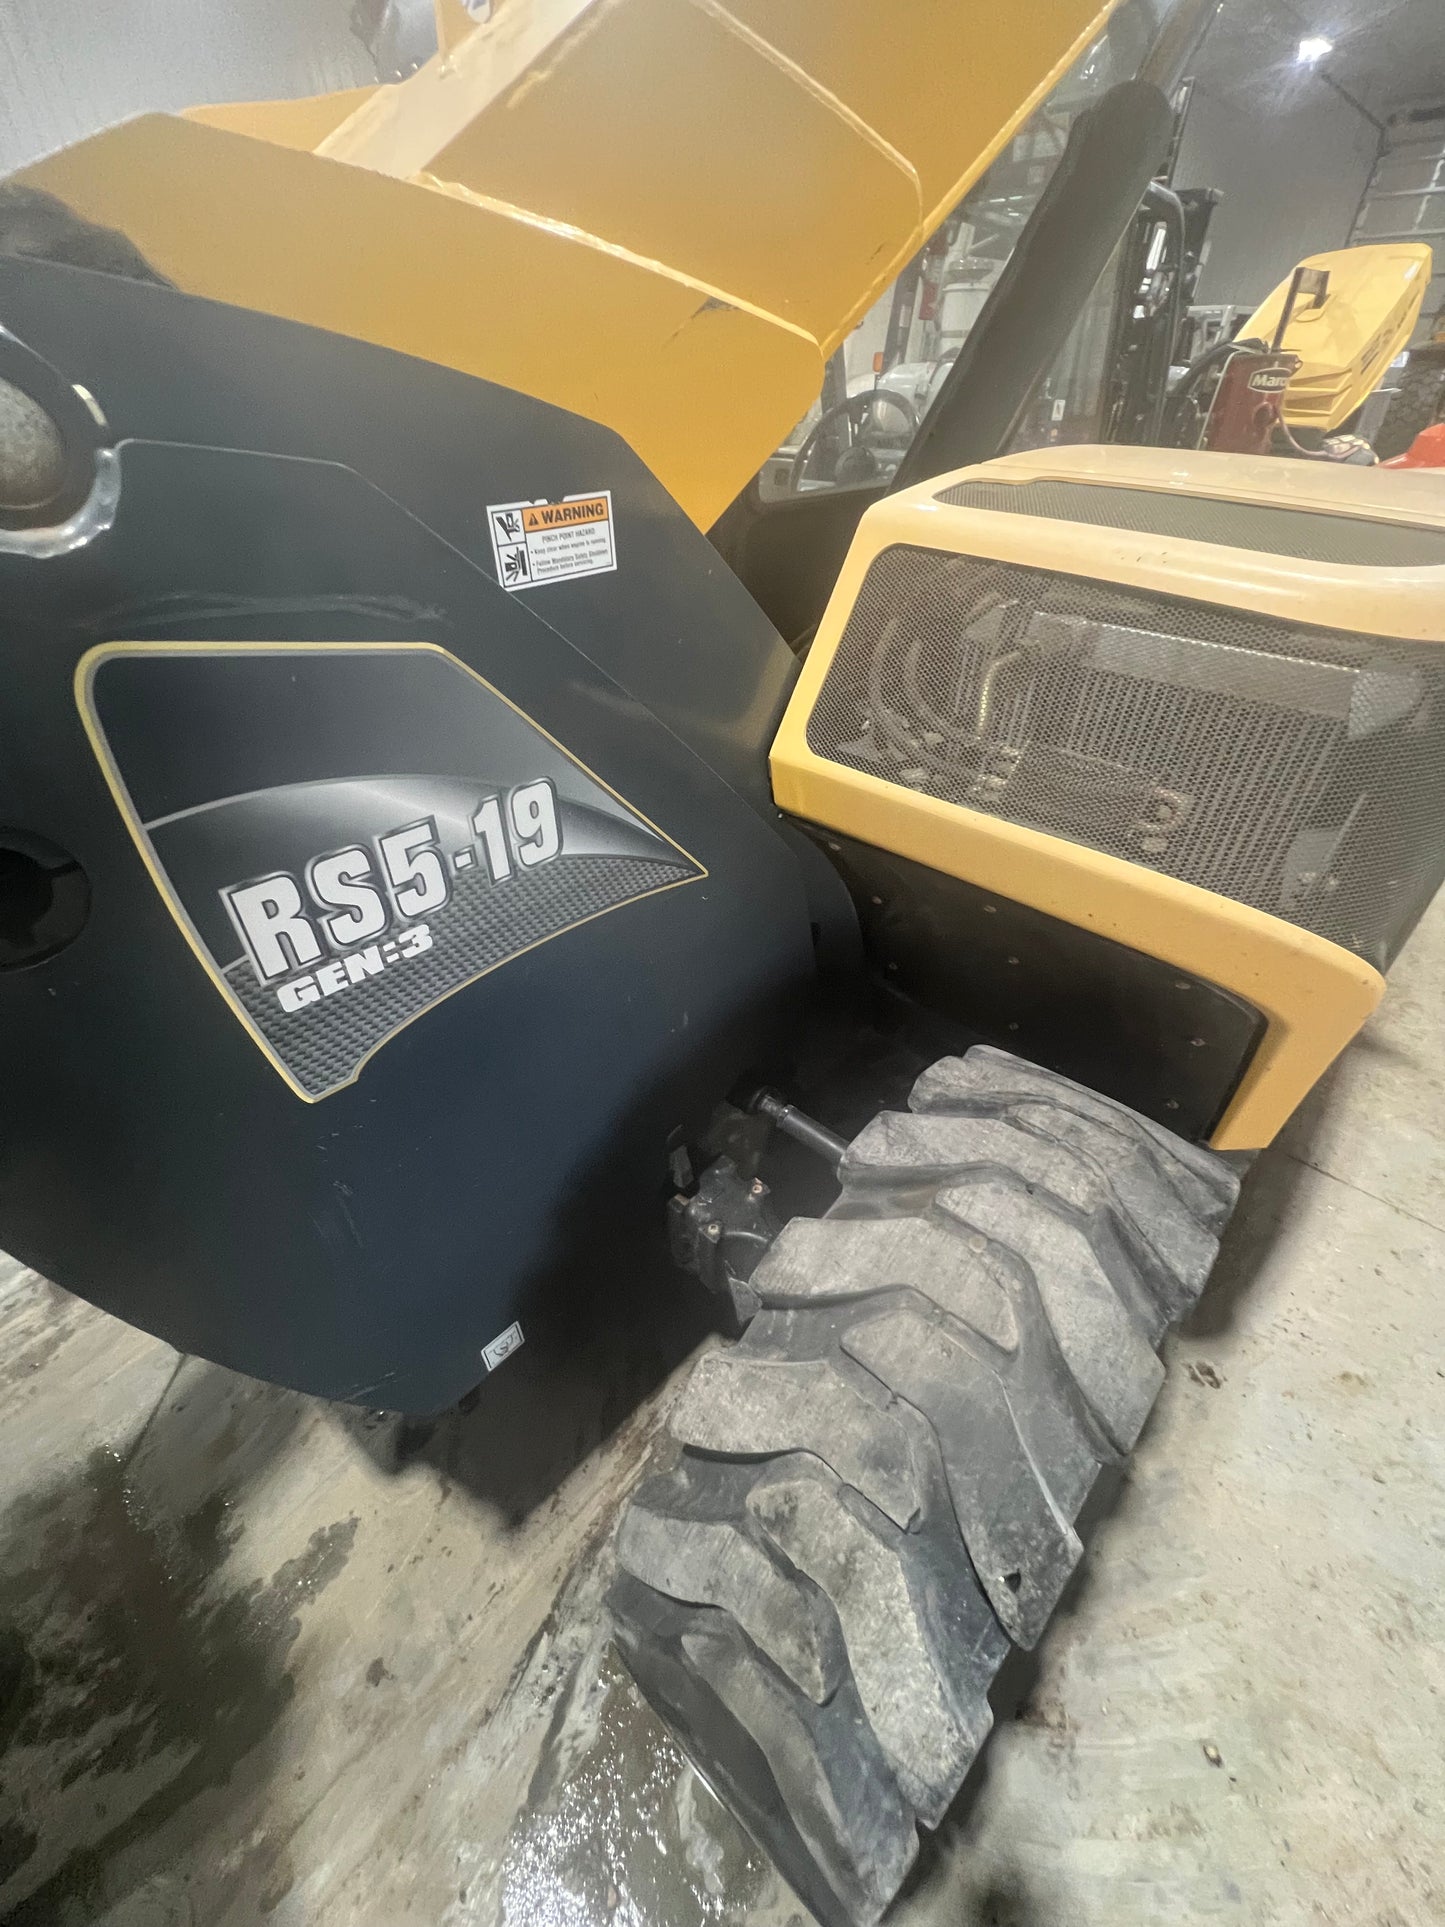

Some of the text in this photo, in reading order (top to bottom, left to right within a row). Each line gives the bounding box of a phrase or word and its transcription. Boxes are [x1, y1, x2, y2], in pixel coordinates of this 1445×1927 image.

[541, 503, 603, 524] WARNING
[542, 528, 595, 543] PINCH POINT HAZARD
[221, 777, 562, 985] RS5-19
